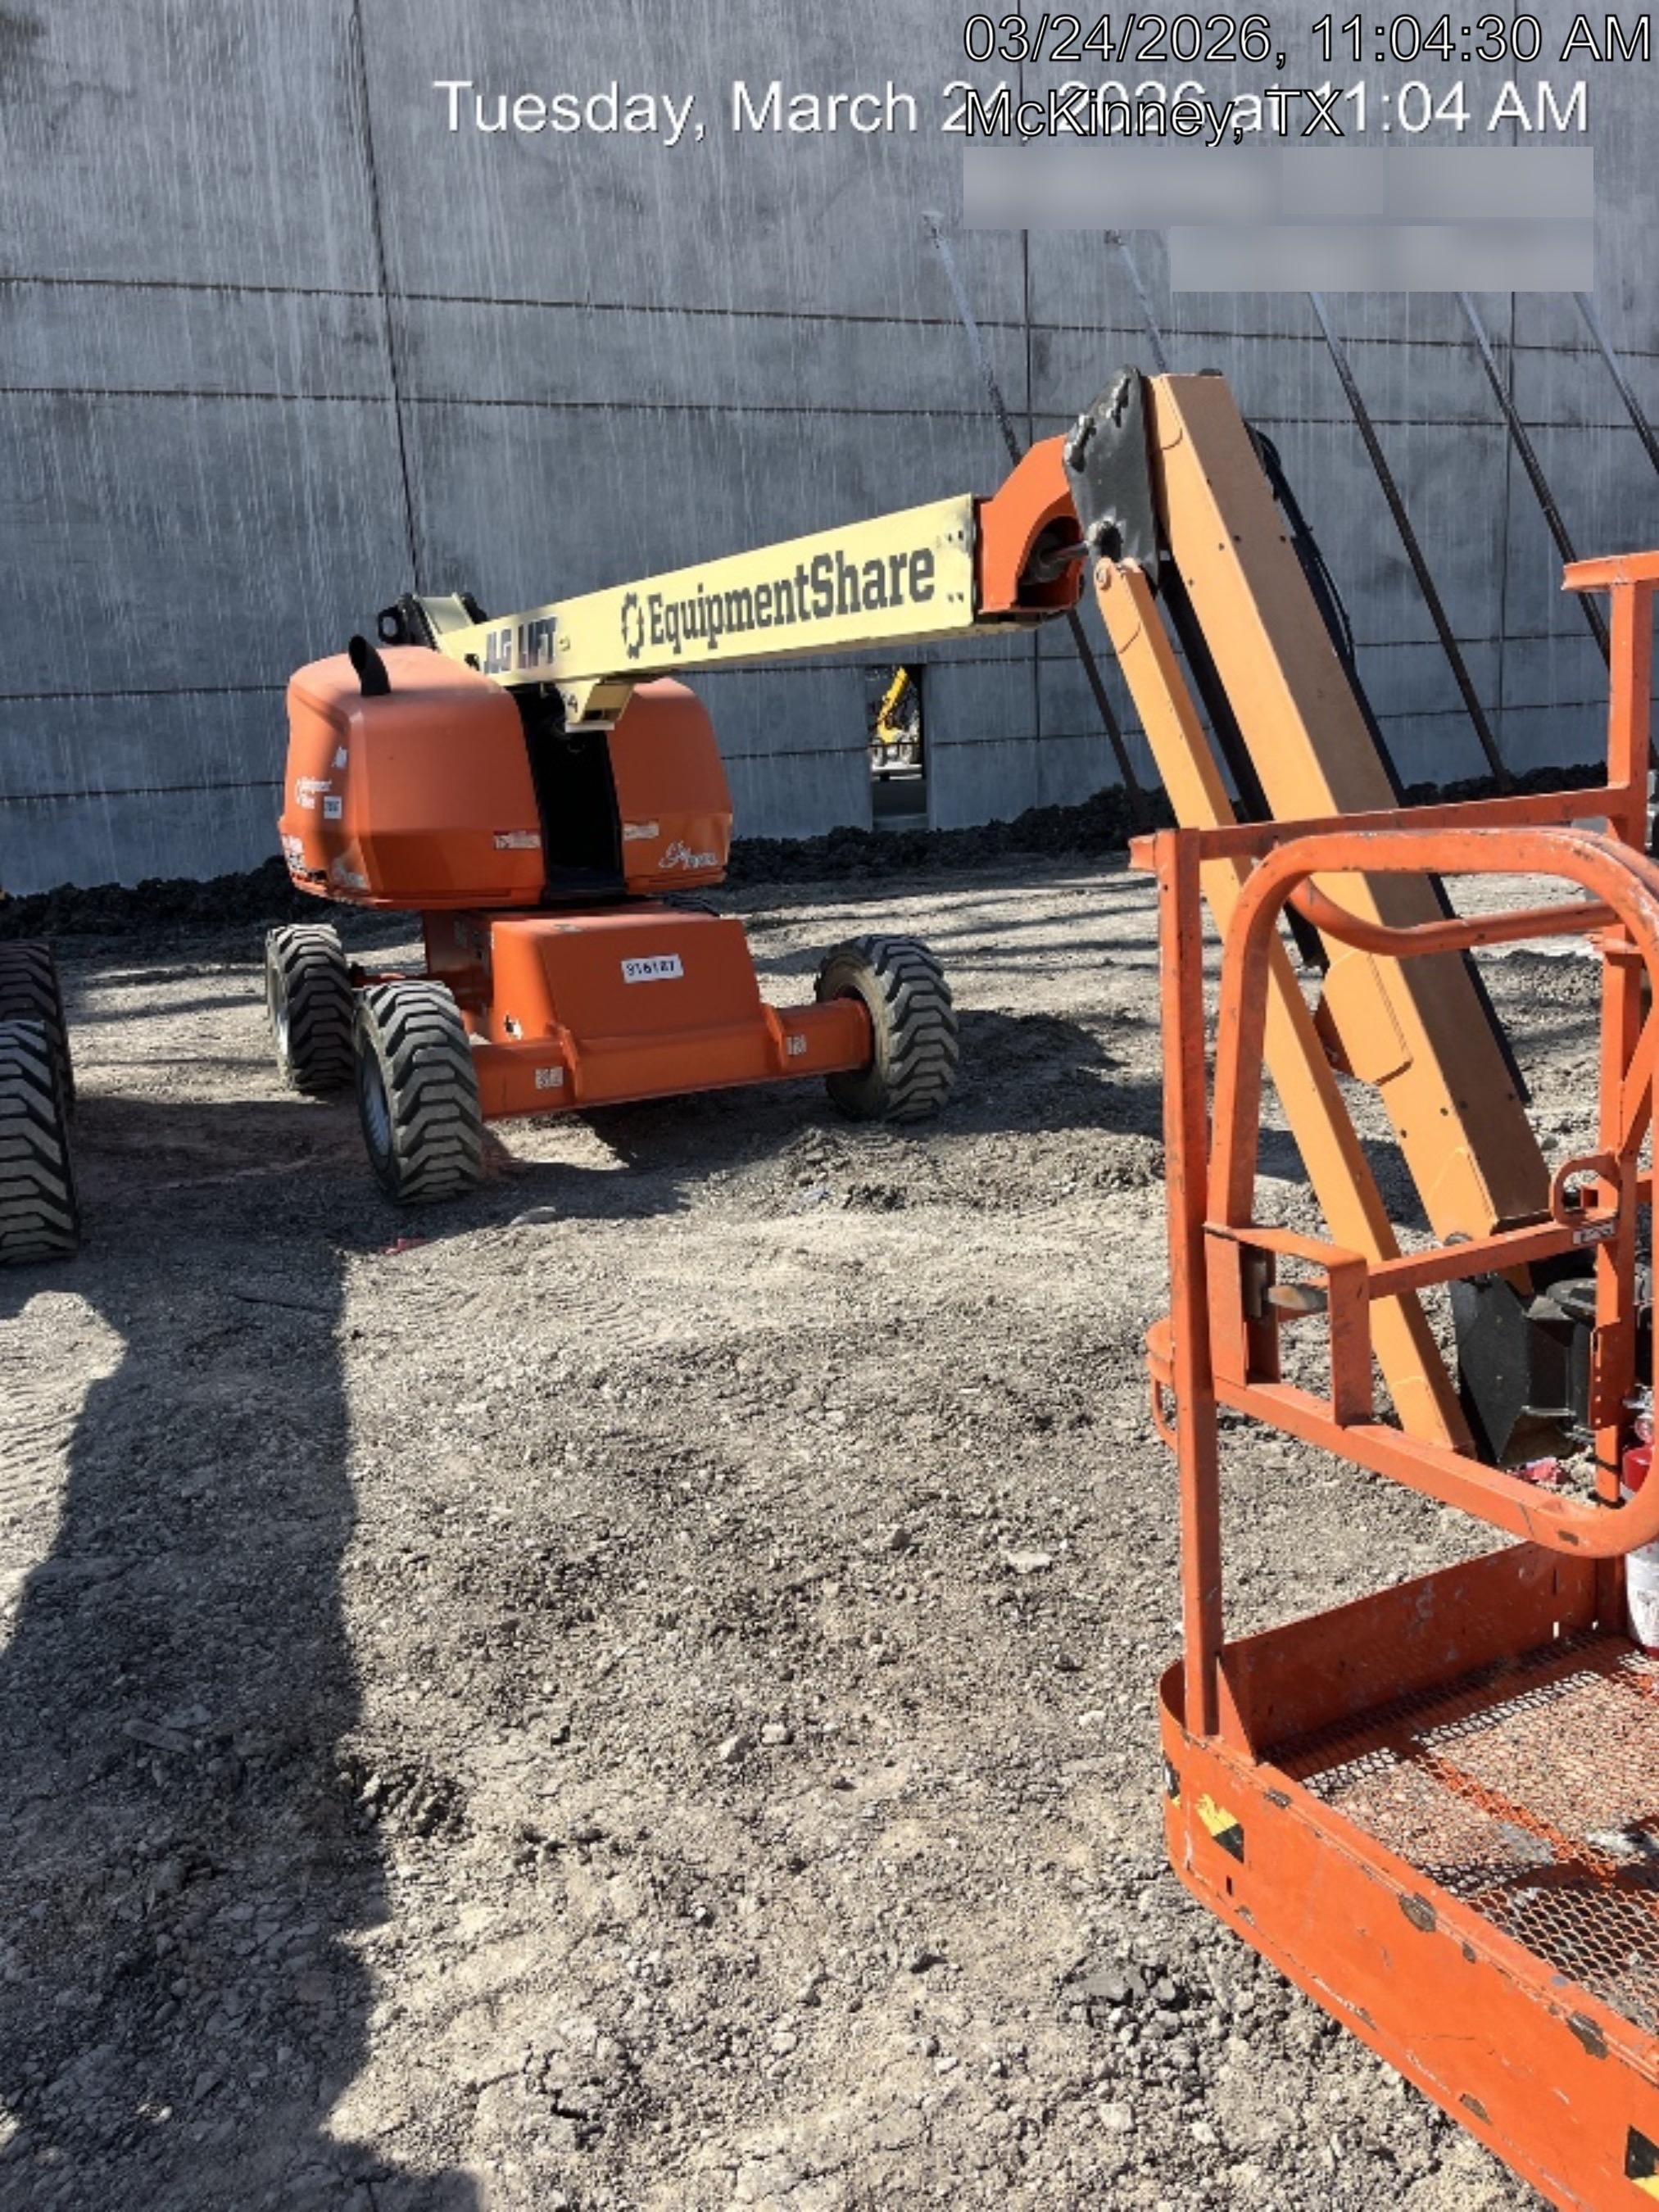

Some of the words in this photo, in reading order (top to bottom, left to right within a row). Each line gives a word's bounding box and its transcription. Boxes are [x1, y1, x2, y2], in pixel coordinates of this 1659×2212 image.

[647, 546, 935, 655] EquipmentShare
[483, 628, 512, 674] JLG
[517, 616, 557, 669] LIFT
